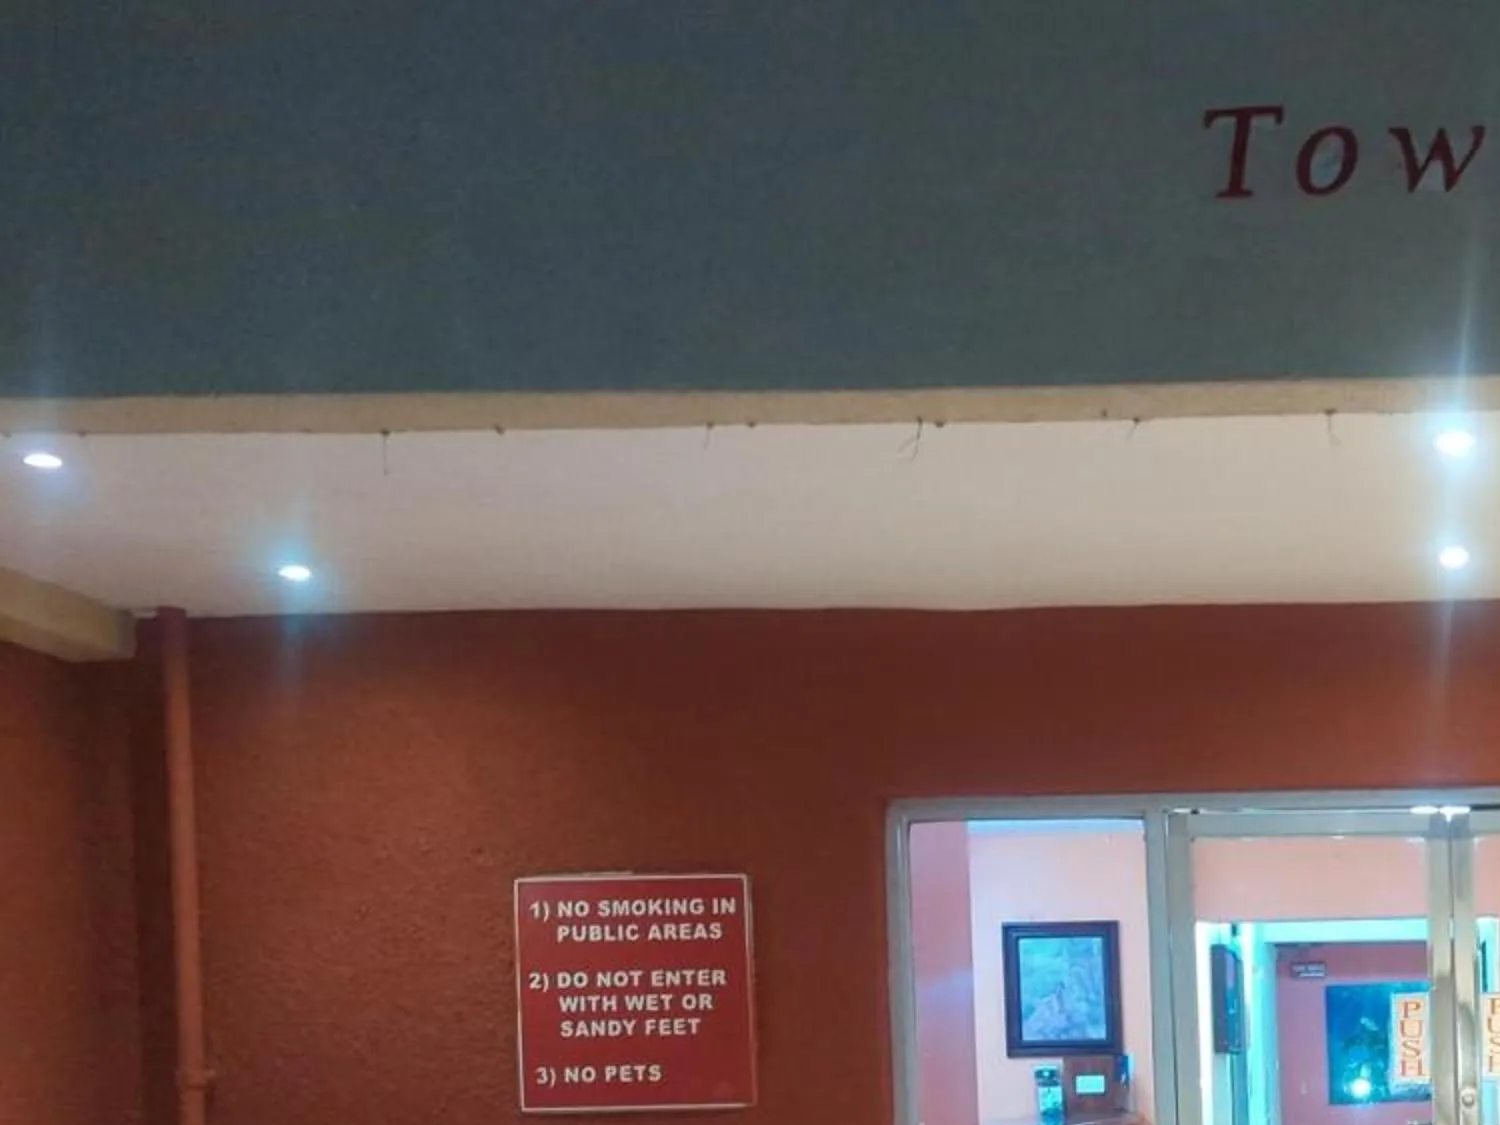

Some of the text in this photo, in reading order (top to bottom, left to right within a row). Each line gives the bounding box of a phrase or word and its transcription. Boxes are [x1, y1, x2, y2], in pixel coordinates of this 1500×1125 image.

[528, 897, 736, 922] 1) NO SMOKING IN
[556, 922, 723, 943] PUBLIC AREAS
[528, 968, 727, 992] 2) DO NOT ENTER
[559, 993, 713, 1013] WITH WET OR
[560, 1018, 701, 1037] SANDY FEET
[1400, 1000, 1424, 1076] PUSH
[536, 1065, 663, 1088] 3) NO PETS
